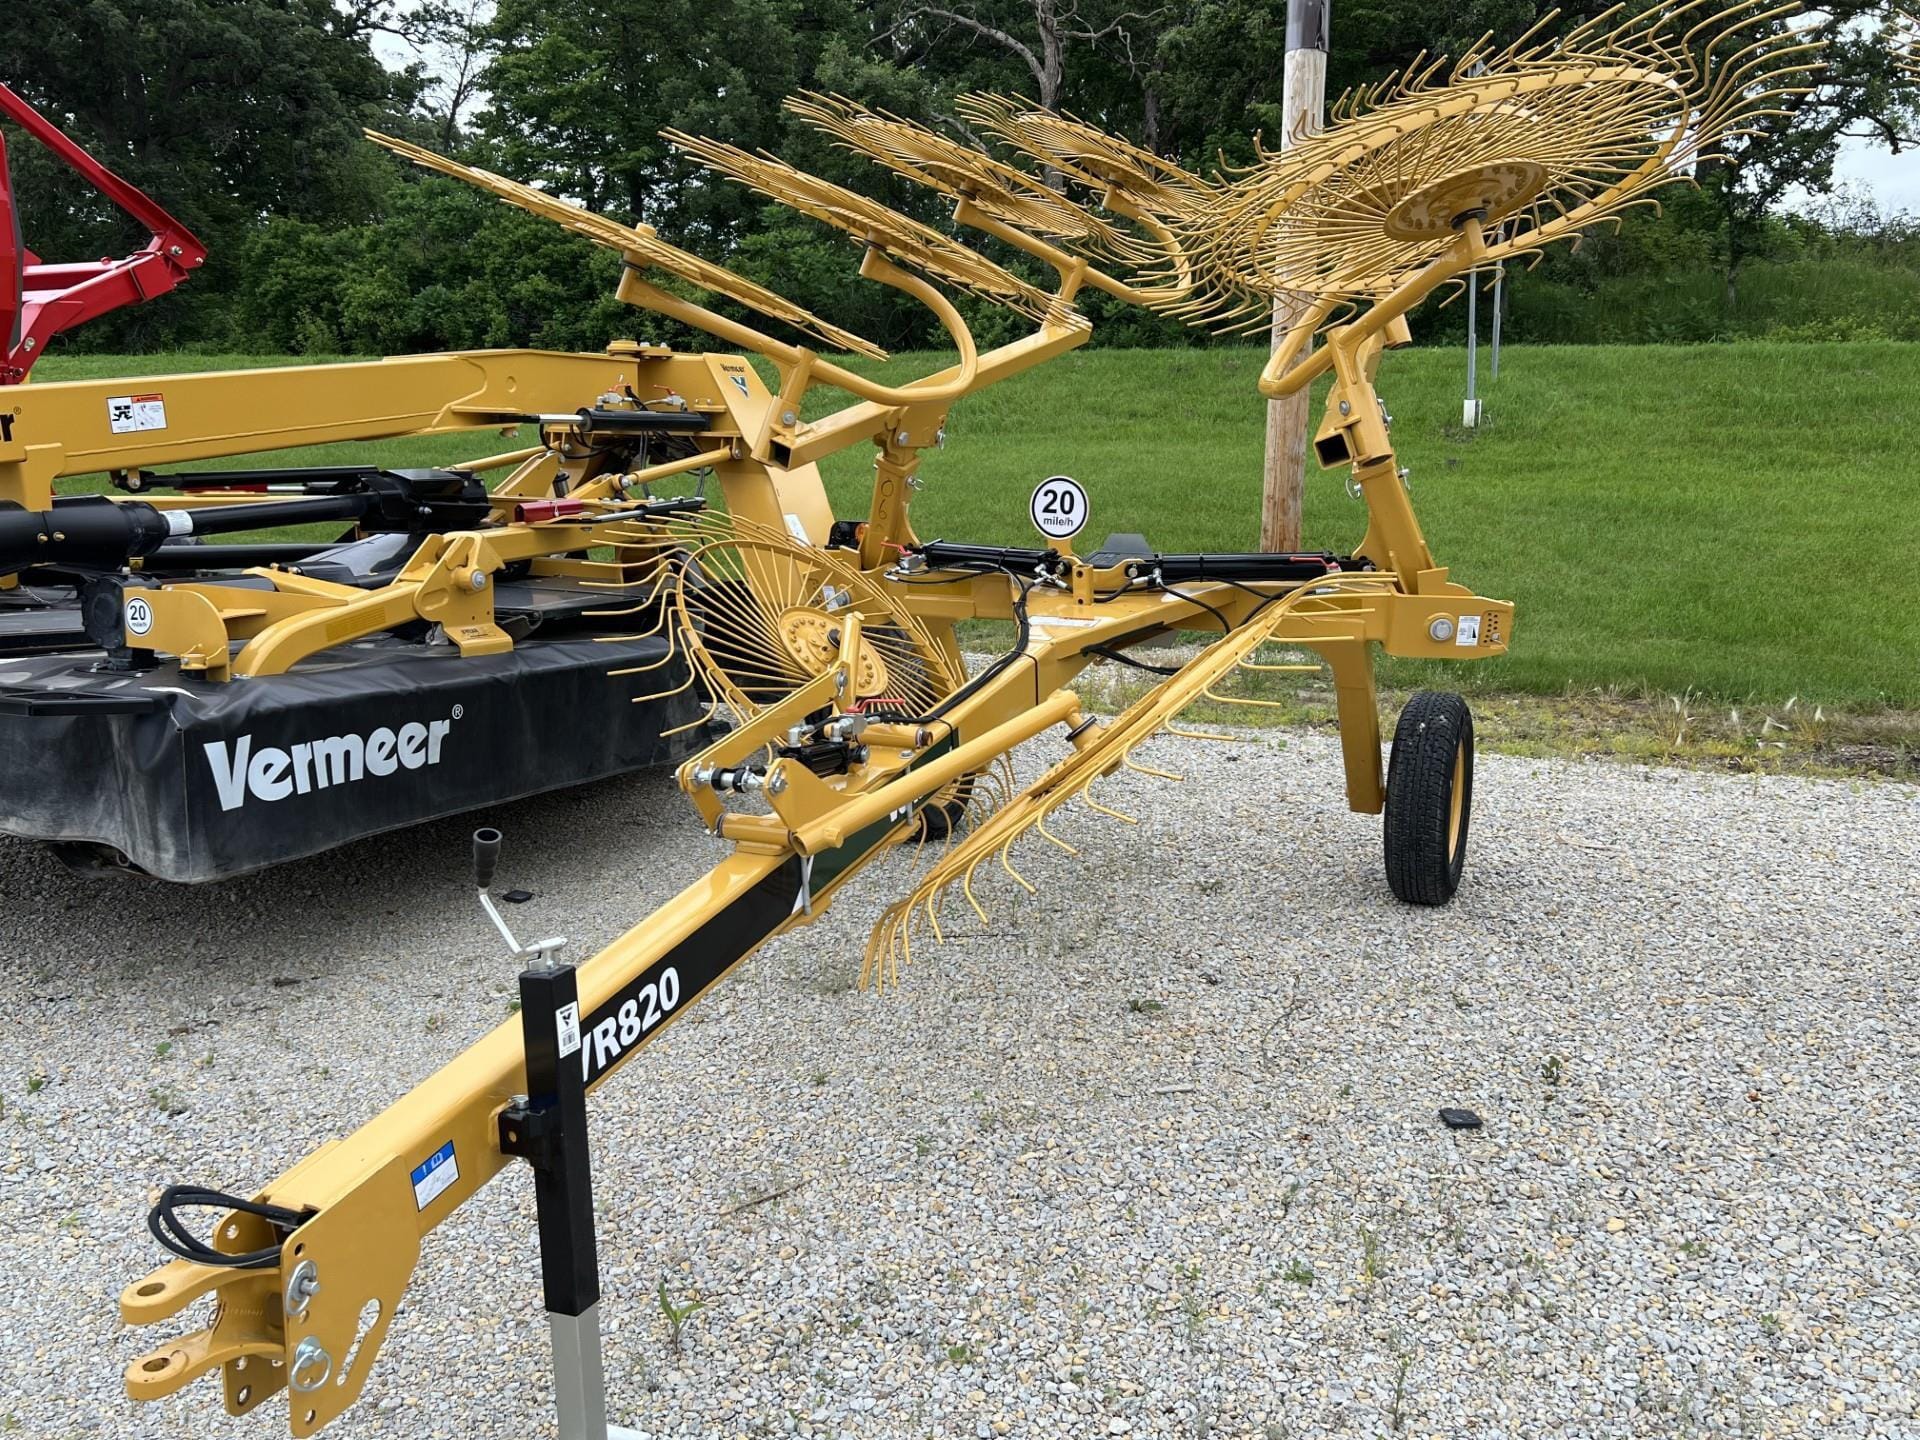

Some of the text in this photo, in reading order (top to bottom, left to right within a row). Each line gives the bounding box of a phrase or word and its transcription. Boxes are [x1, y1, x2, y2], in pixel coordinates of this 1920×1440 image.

[1042, 489, 1075, 515] 20
[1043, 516, 1074, 527] mile/h
[130, 605, 146, 621] 20
[203, 719, 450, 812] Vermeer
